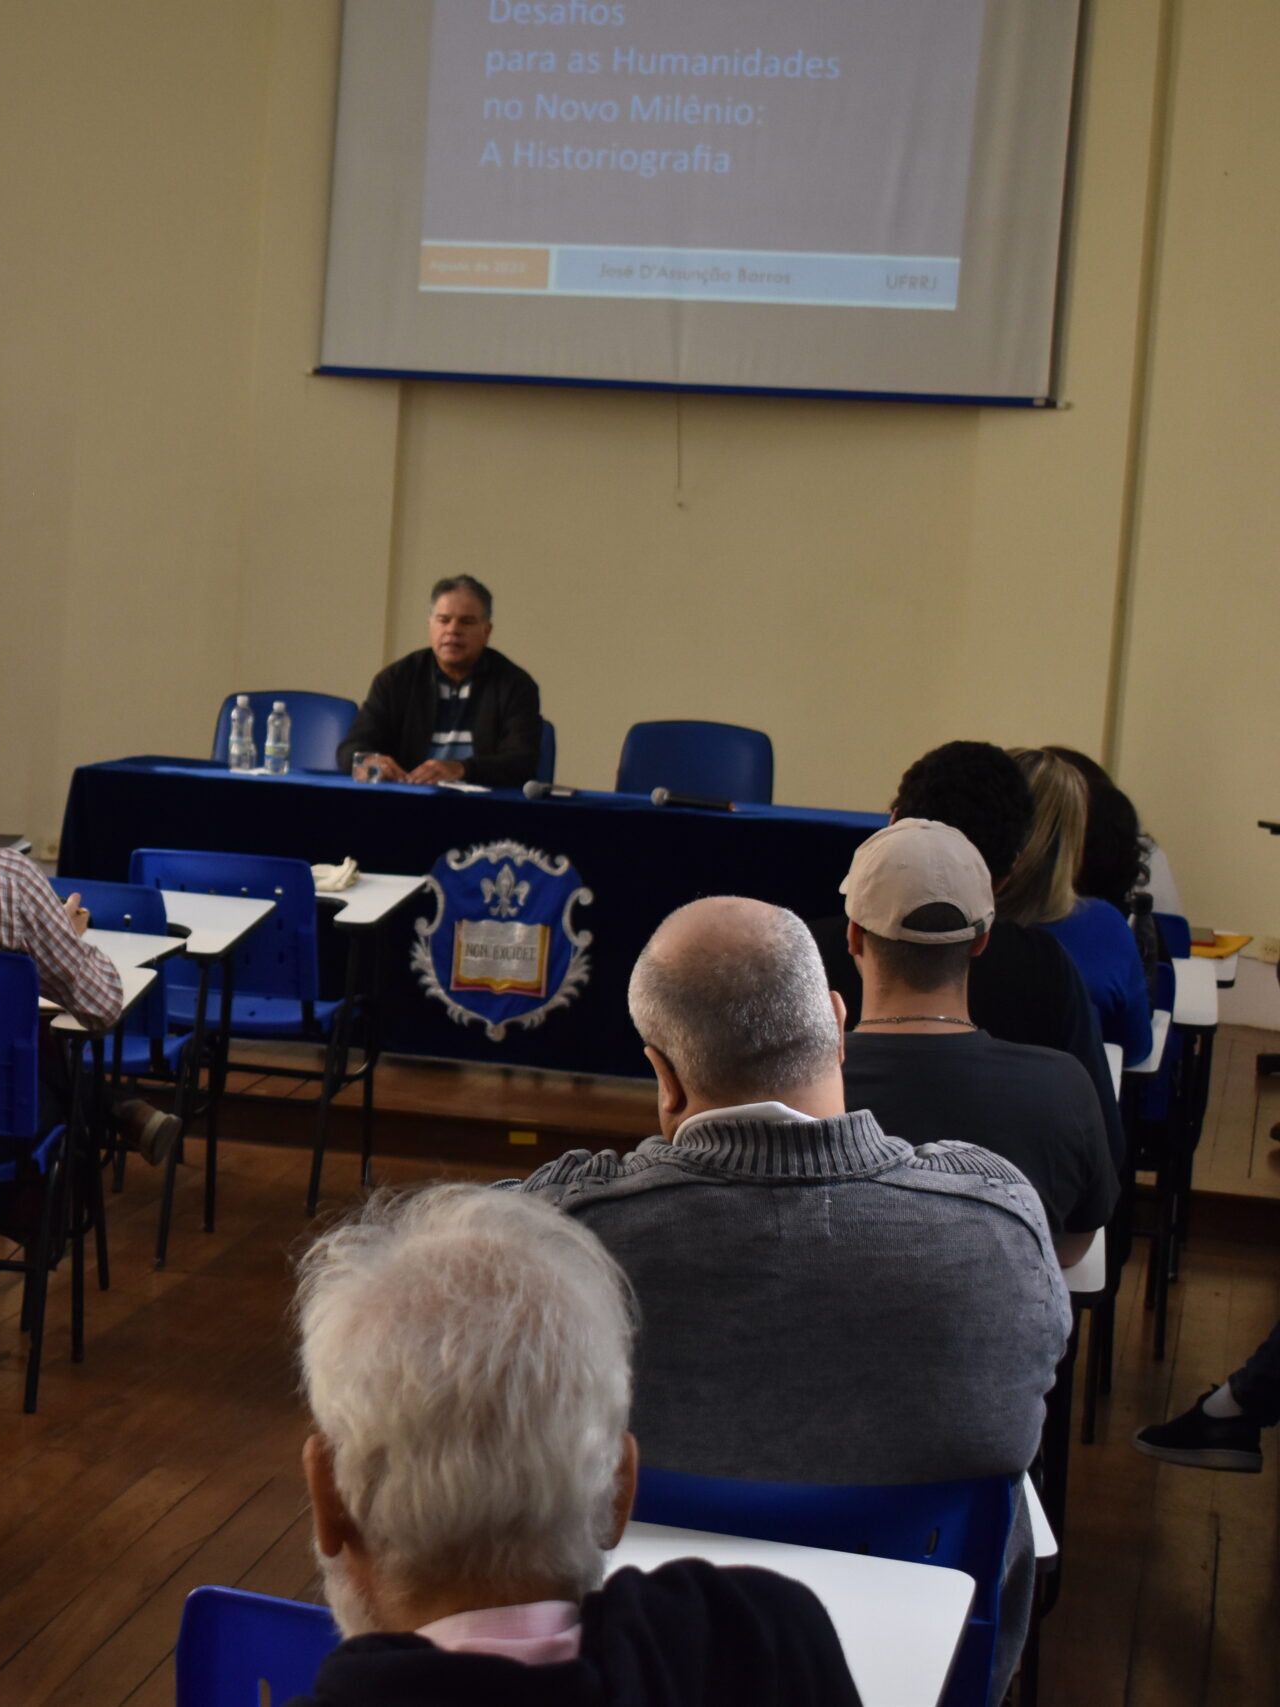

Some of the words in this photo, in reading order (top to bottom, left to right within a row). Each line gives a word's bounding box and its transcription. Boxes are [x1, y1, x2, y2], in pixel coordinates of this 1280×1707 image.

[488, 0, 626, 26] Desafios
[485, 50, 556, 77] para
[568, 50, 600, 74] as
[612, 47, 841, 79] Humanidades
[483, 98, 522, 120] no
[535, 94, 618, 122] Novo
[630, 95, 764, 126] Milênio:
[479, 141, 502, 167] A
[513, 141, 730, 178] Historiografia
[599, 263, 634, 280] José
[737, 266, 792, 285] Barros
[464, 943, 488, 958] NON
